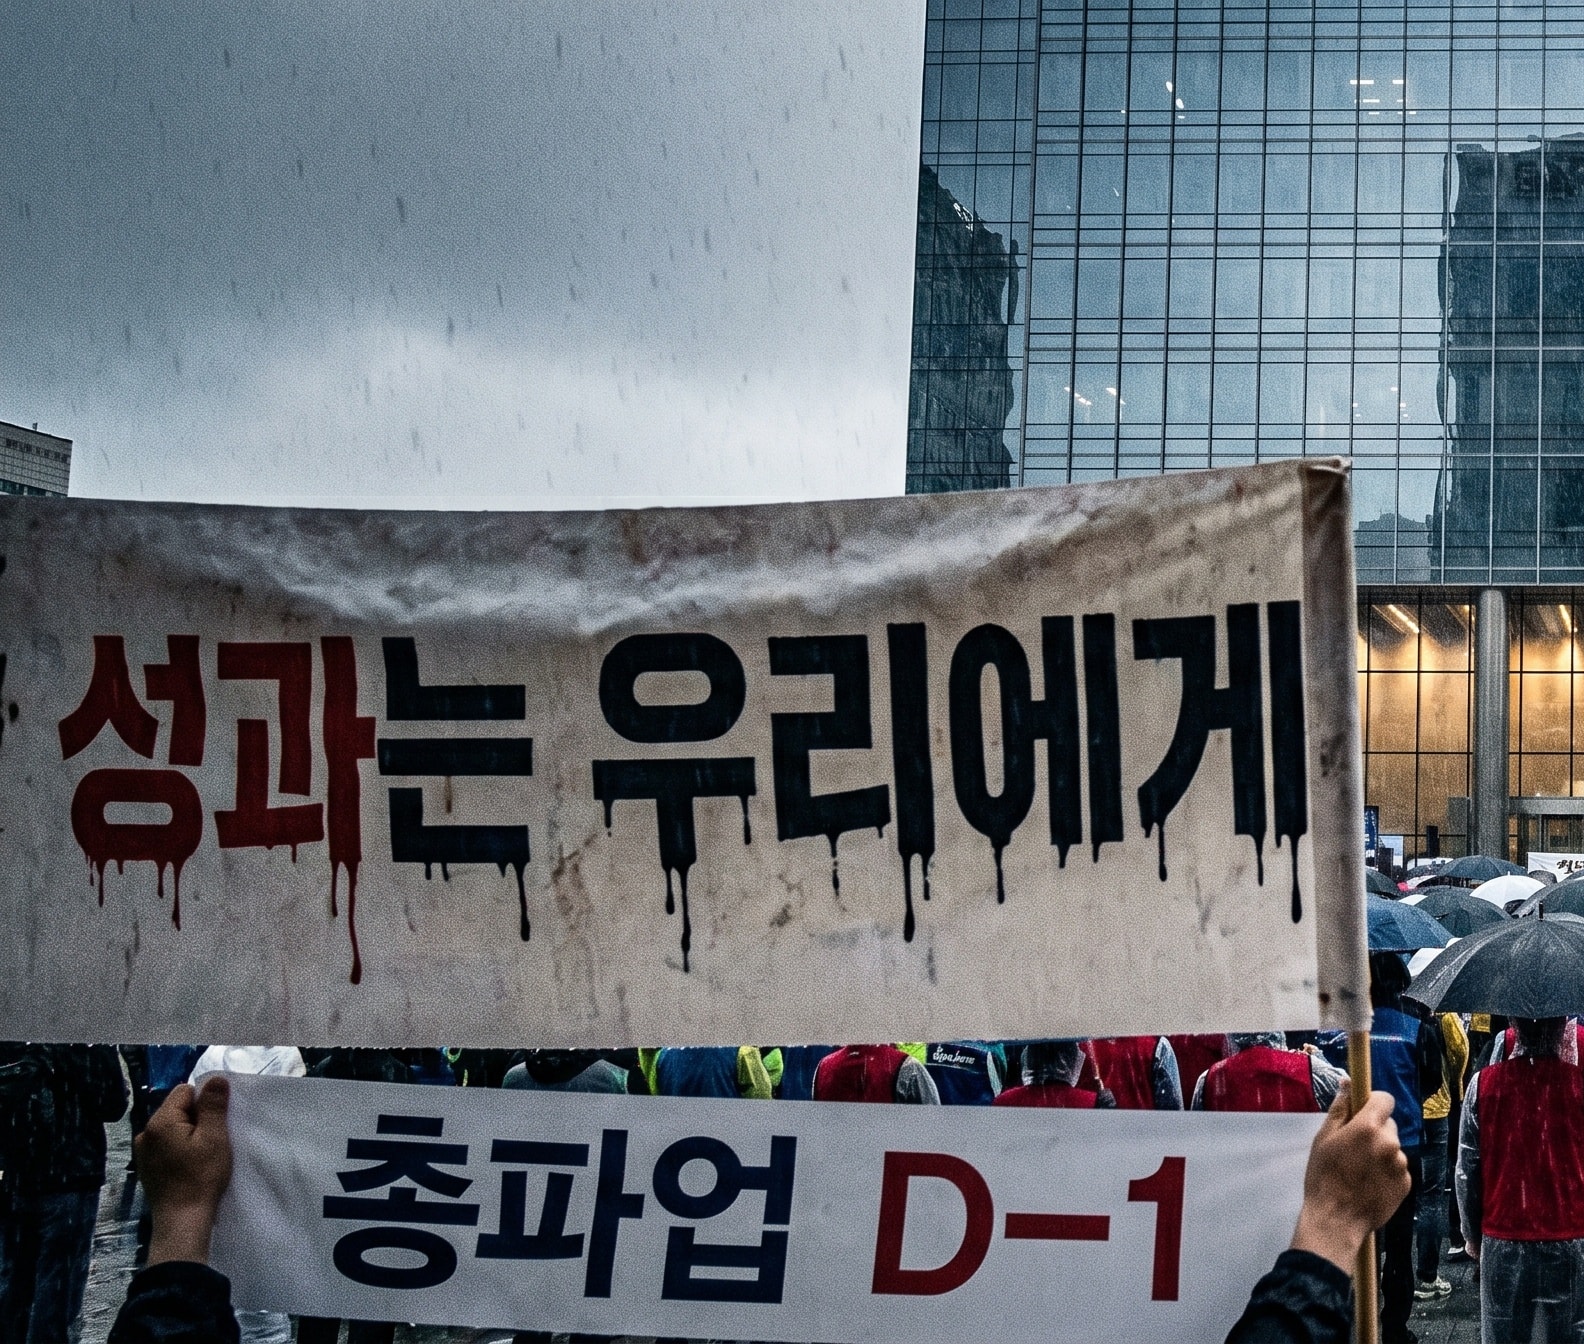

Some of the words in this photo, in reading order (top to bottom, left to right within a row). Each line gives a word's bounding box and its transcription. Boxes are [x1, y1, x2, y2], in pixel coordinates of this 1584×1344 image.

[58, 634, 533, 935] 성과는
[592, 600, 1309, 930] 우리에게
[322, 1114, 798, 1304] 총파업
